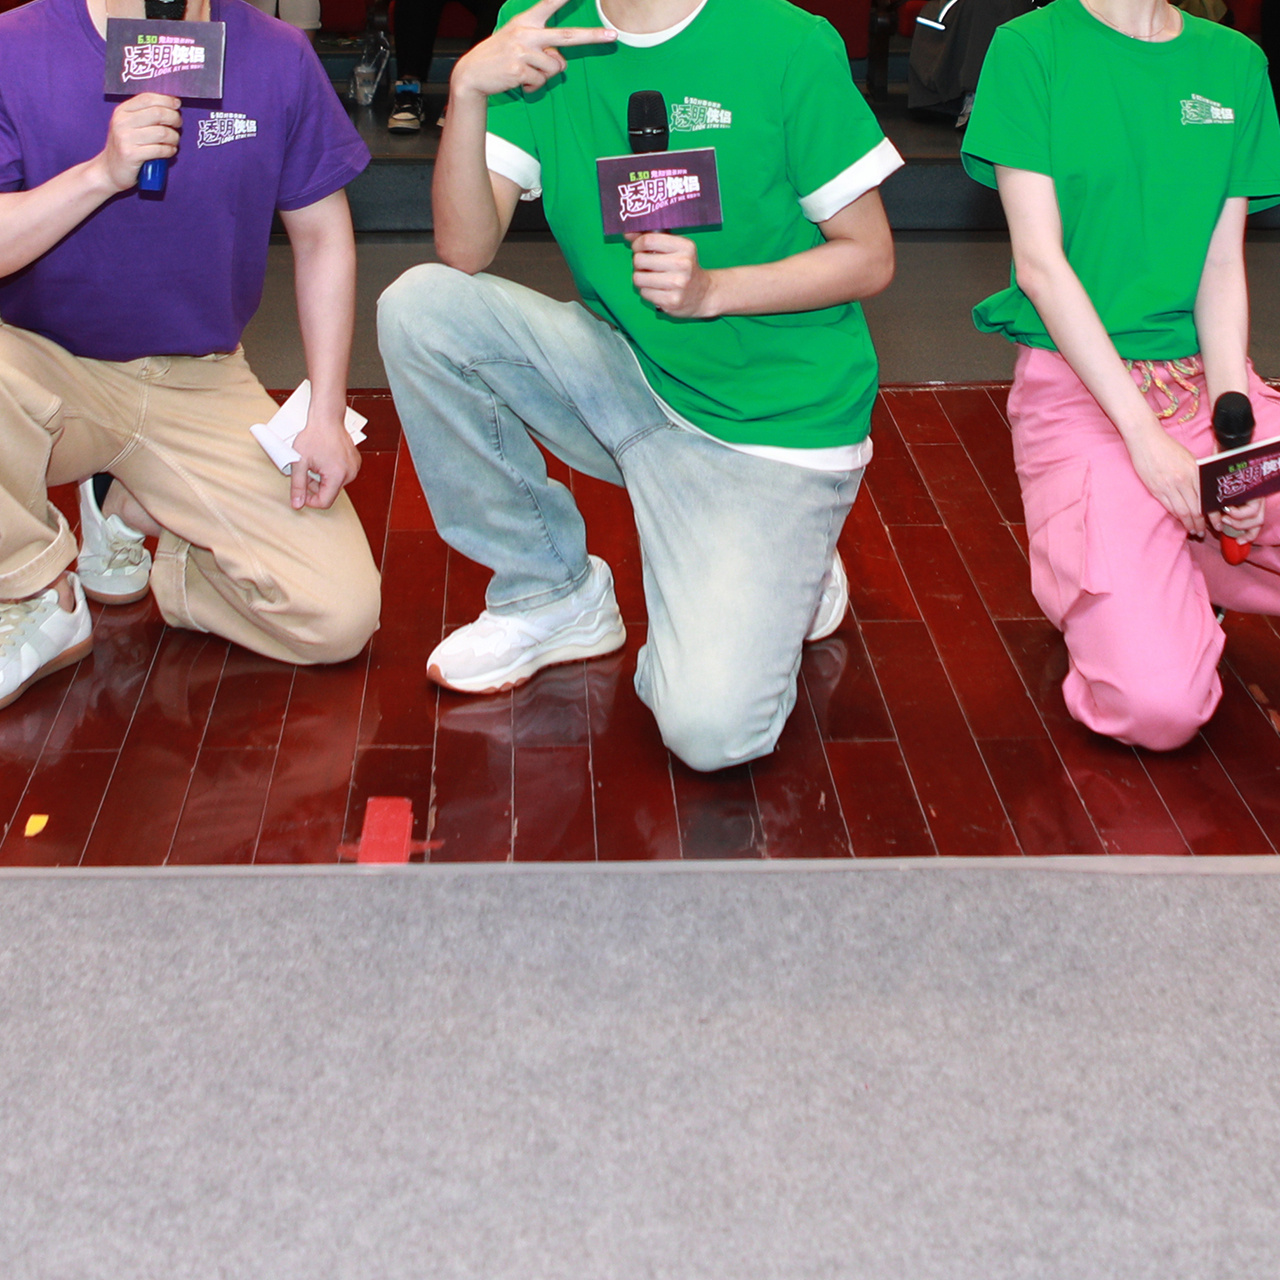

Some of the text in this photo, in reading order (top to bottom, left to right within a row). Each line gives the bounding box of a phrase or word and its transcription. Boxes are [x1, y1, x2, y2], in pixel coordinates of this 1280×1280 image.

[122, 44, 205, 83] 透明侠侣
[197, 118, 257, 149] 透明侠侣
[669, 104, 732, 133] 透明侠侣
[629, 170, 650, 182] 6.30
[618, 175, 701, 222] 透明侠侣
